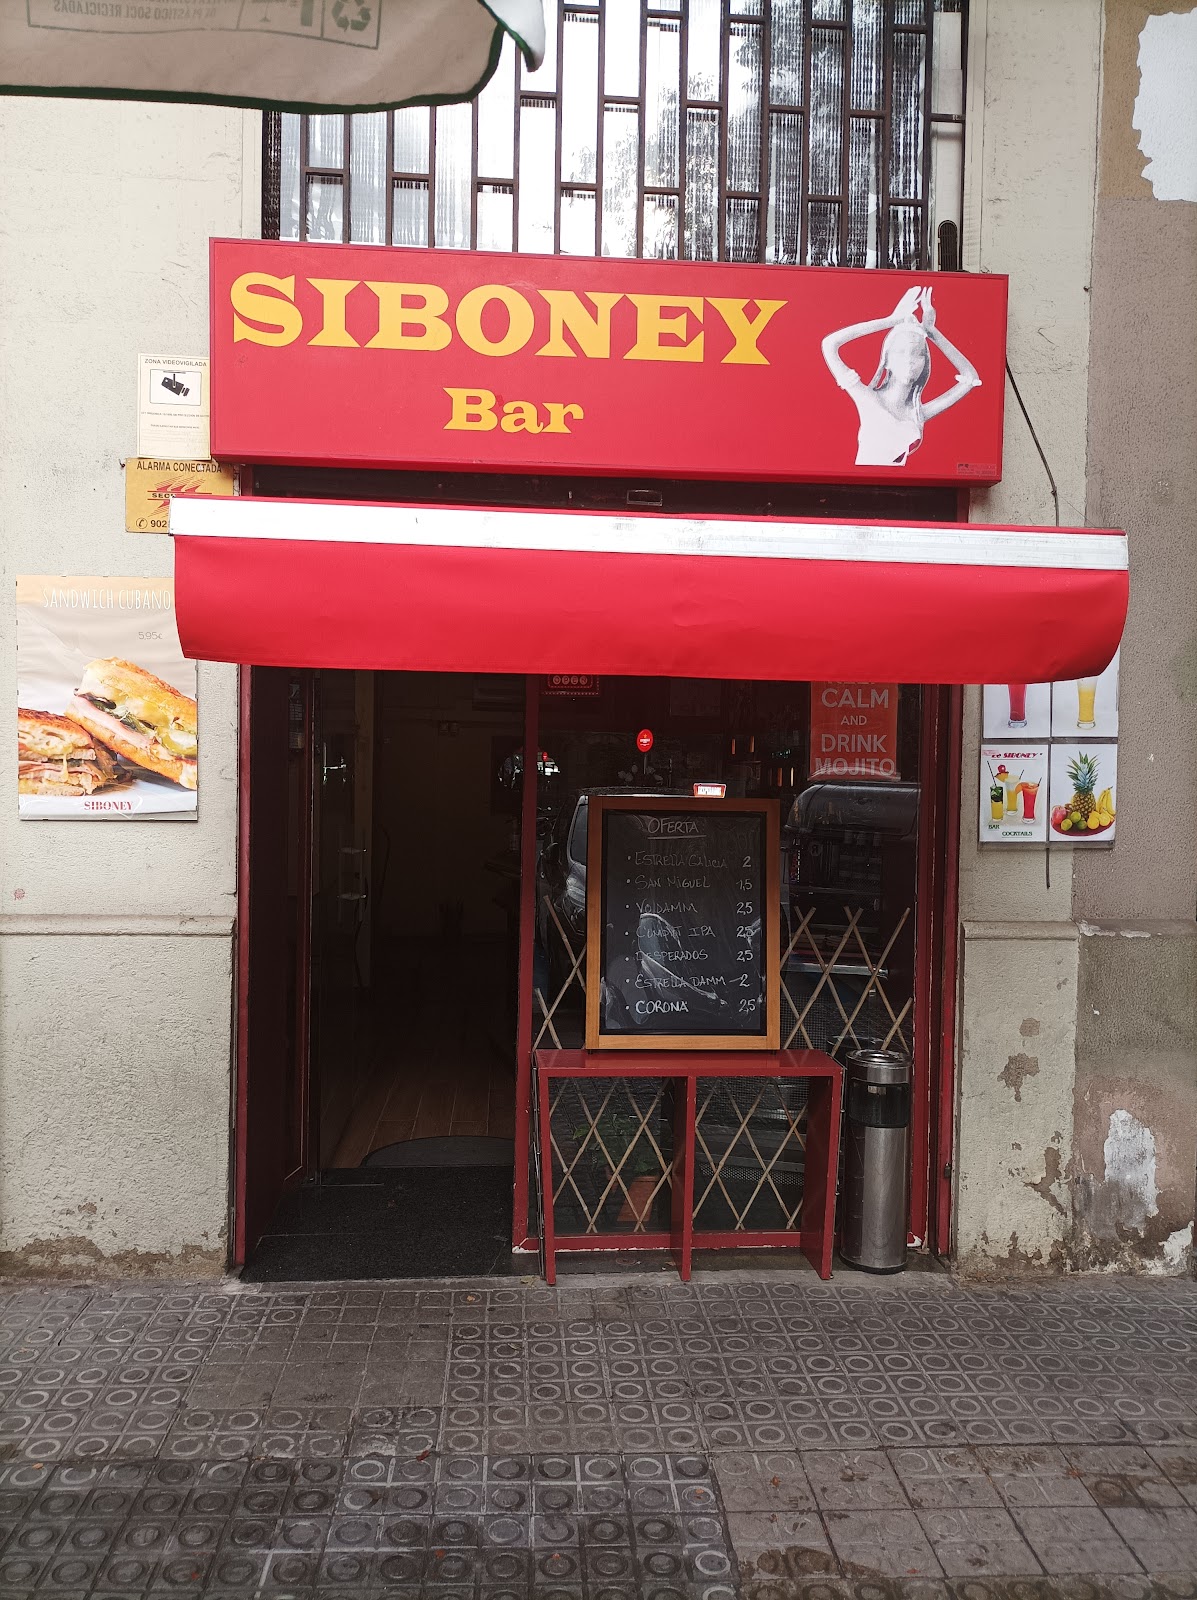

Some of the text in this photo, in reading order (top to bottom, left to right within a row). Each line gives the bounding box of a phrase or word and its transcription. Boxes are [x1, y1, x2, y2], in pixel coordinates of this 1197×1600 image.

[230, 271, 789, 366] SIBONEY
[162, 359, 207, 367] VIDEOVIGILADA
[443, 387, 584, 434] Bar
[136, 460, 222, 473] ALARMA CONECTADA
[150, 519, 168, 528] 902
[43, 588, 172, 610] SANDWICH CUBANO
[821, 688, 889, 709] CALM
[840, 715, 868, 726] AND
[821, 733, 887, 753] DRINK
[815, 757, 895, 776] MOJITO
[83, 801, 133, 811] SIBONEY
[647, 817, 699, 834] OFERTA
[742, 855, 752, 868] 2
[634, 874, 662, 890] SAN
[667, 875, 711, 890] MIGUEL
[736, 901, 753, 916] 2,5
[688, 925, 717, 938] IPA
[634, 949, 754, 963] DESPERADOS 2,5
[634, 973, 751, 990] ESTRELLA DAMM 2
[635, 998, 756, 1014] CORONA 2,5
